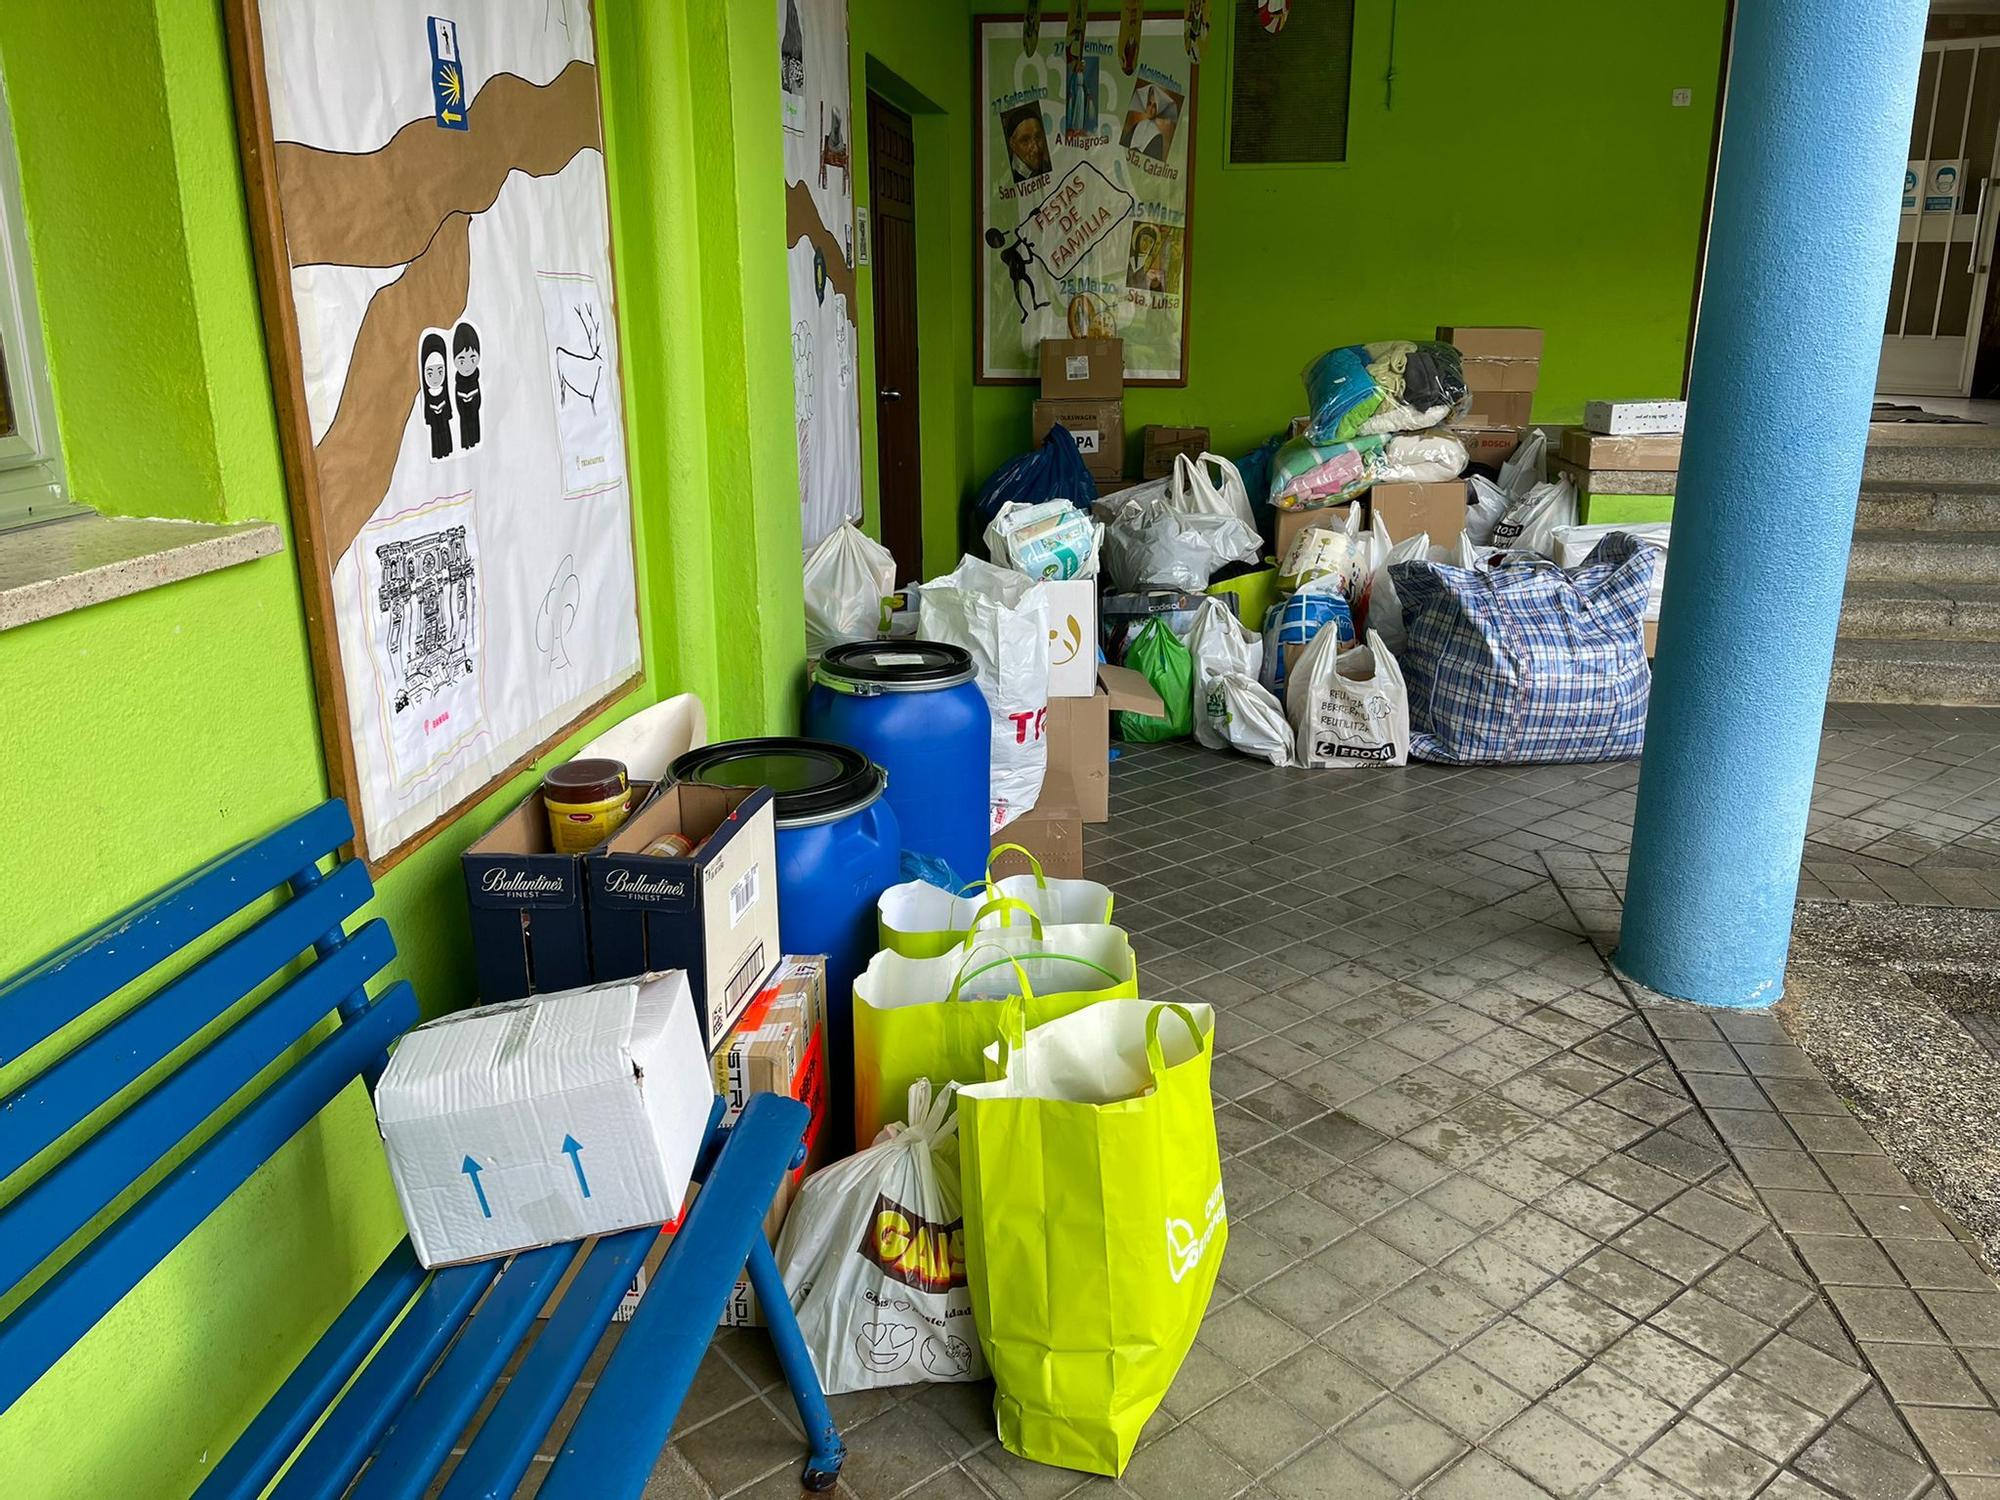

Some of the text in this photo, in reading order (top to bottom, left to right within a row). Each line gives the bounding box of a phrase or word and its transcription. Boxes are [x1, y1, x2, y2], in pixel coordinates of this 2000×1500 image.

[1055, 132, 1110, 151] A Milagrosa
[1126, 150, 1179, 180] Sta. Catalina
[999, 173, 1051, 200] San Vicente
[1034, 175, 1086, 231] FESTAS
[1059, 205, 1083, 235] DE
[1050, 206, 1112, 270] FAMILIA
[1060, 277, 1117, 295] 25 Marzo
[1127, 289, 1180, 310] Sta. Luisa
[1076, 436, 1094, 448] PA
[1482, 440, 1512, 448] BOSCH
[1340, 746, 1392, 760] EROSKI
[481, 867, 563, 892] Ballantine's
[605, 869, 685, 897] Ballantine's
[507, 891, 539, 899] FINEST
[628, 893, 661, 902] FINEST
